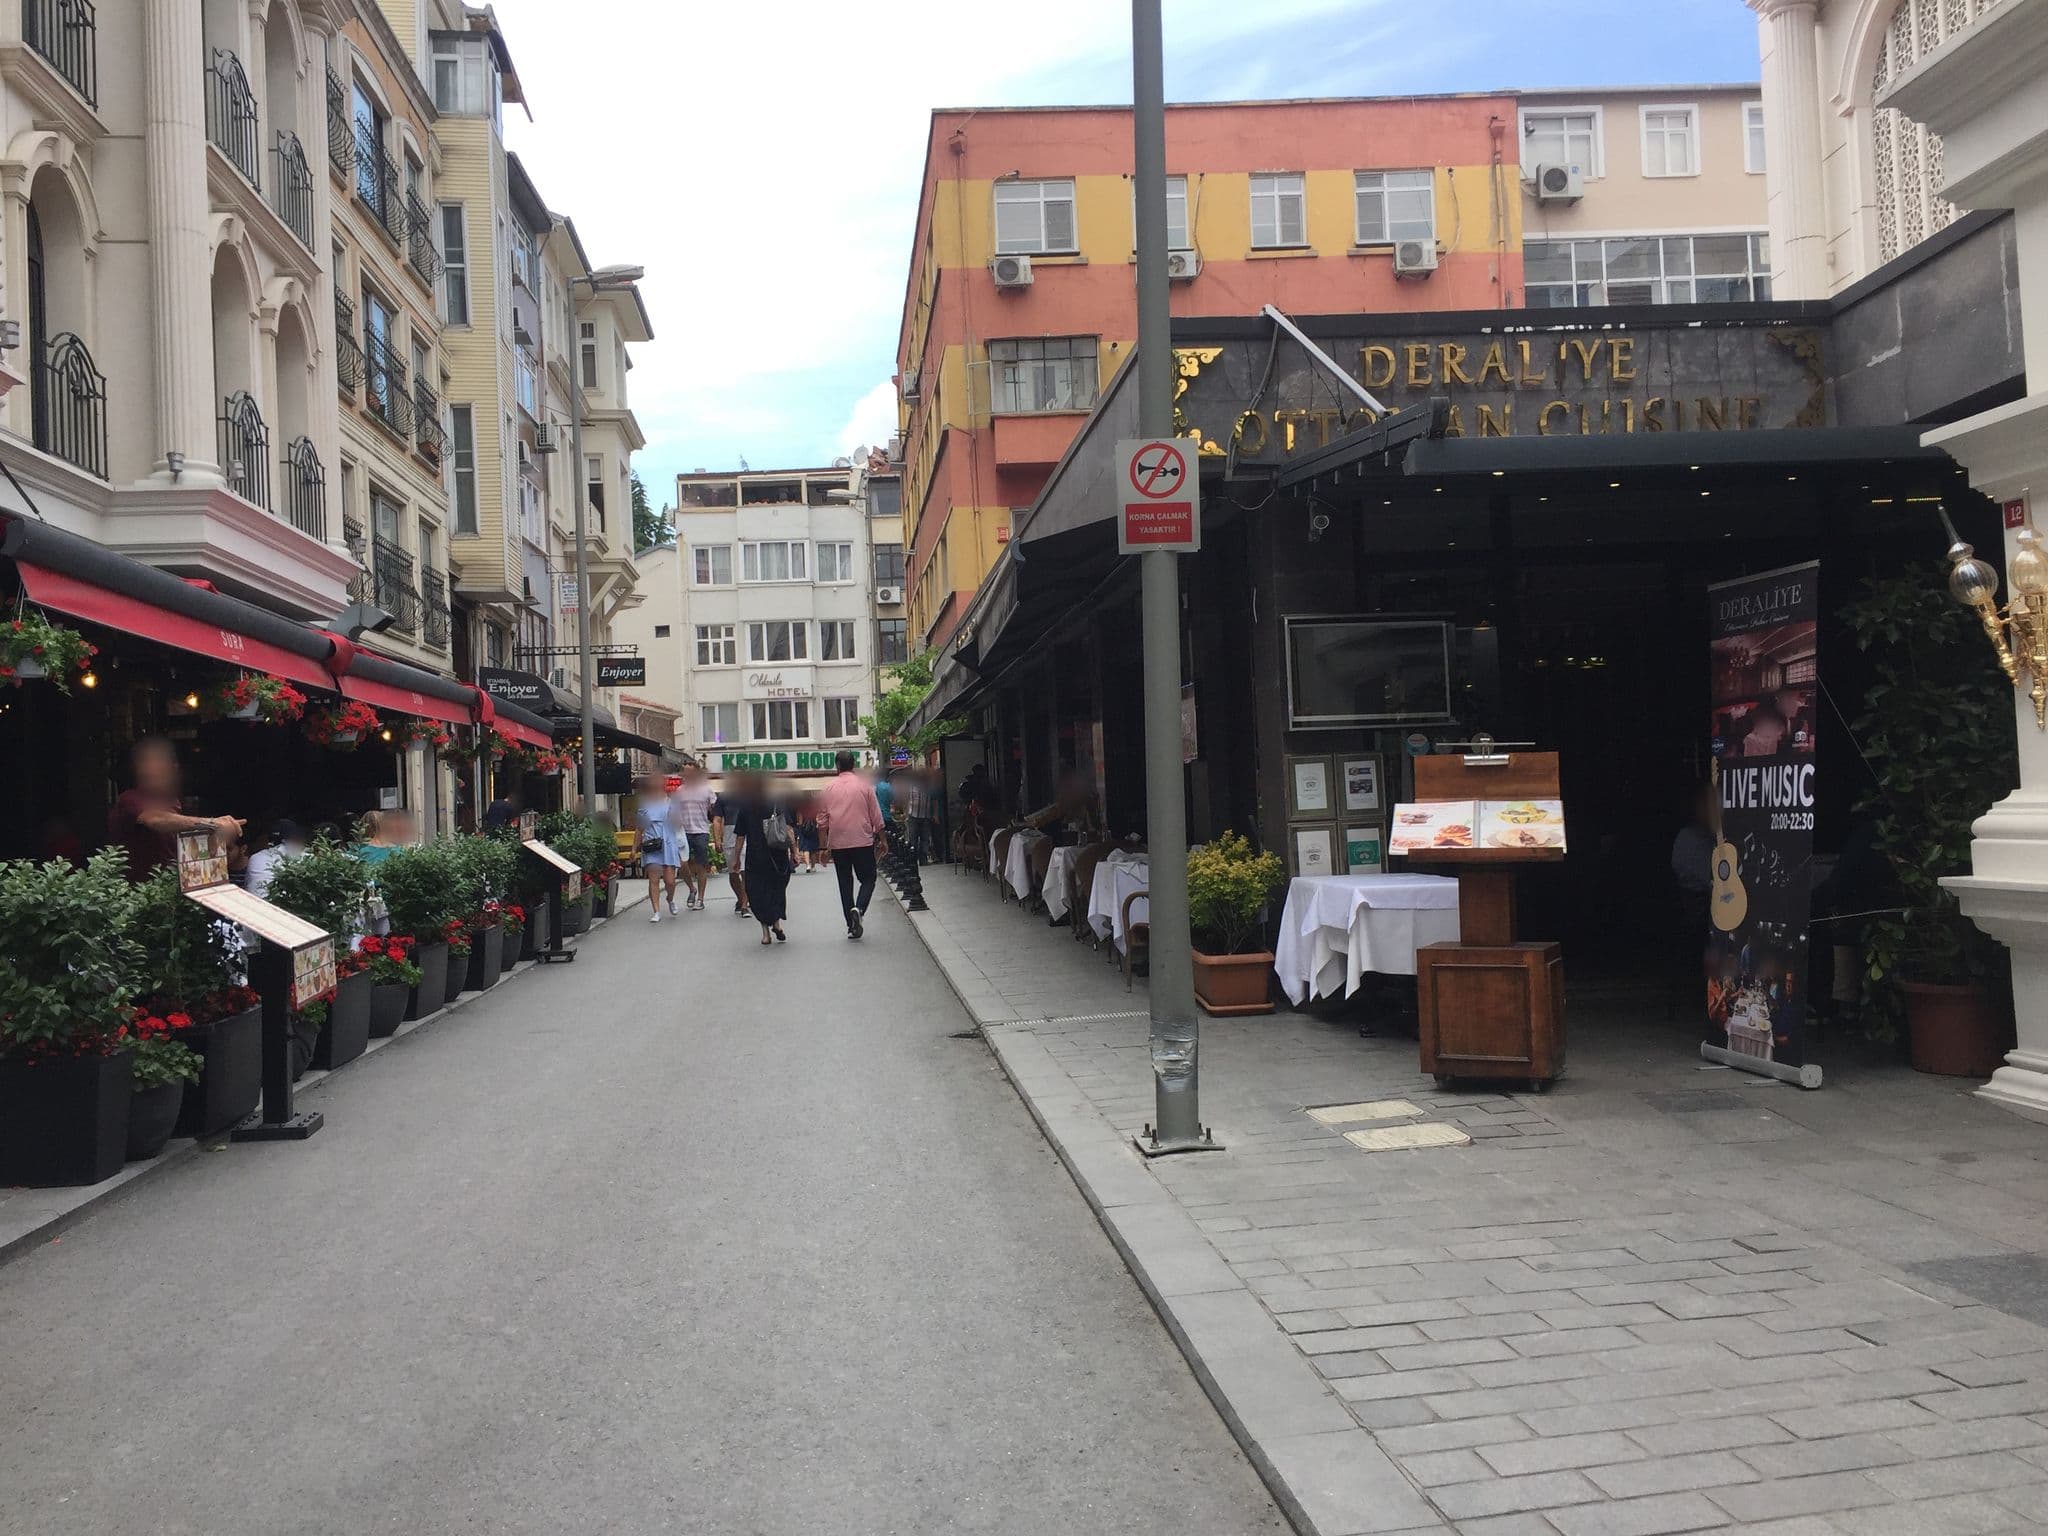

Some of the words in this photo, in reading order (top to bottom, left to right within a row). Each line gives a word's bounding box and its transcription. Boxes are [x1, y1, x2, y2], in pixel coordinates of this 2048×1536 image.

[1233, 402, 1512, 452] OTTAN
[1129, 513, 1155, 521] KORNA
[2010, 505, 2023, 521] 12
[220, 630, 245, 652] SURA
[600, 665, 643, 680] Enjoyer
[488, 683, 539, 698] Enjoyer
[767, 687, 809, 697] HOTEL
[721, 752, 788, 770] KEBAB
[796, 751, 861, 769] HOUE
[1722, 767, 1759, 809] LIVE
[1761, 763, 1816, 808] MUSIC
[1770, 813, 1815, 831] 20:00-22:30
